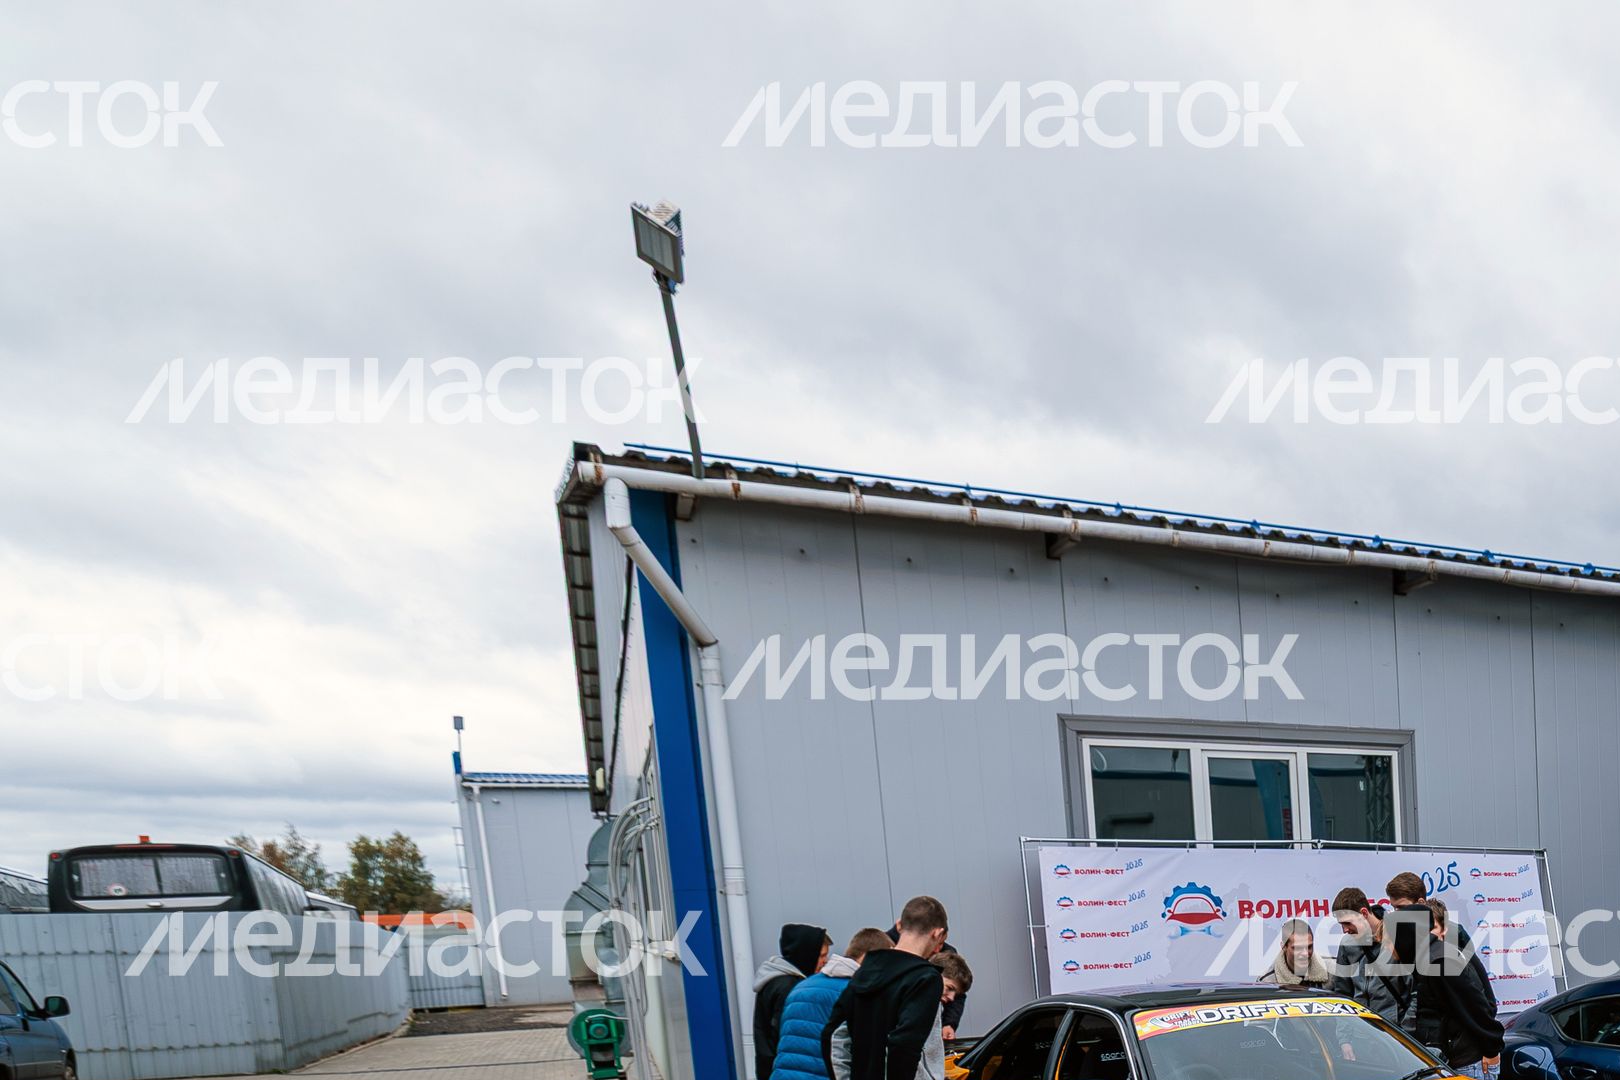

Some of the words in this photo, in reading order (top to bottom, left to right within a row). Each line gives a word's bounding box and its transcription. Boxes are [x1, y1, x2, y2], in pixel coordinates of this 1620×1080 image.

[1421, 861, 1461, 897] 025
[1195, 1002, 1289, 1023] DRIFT
[1290, 1001, 1357, 1015] TAXI
[1101, 1051, 1127, 1061] sparc
